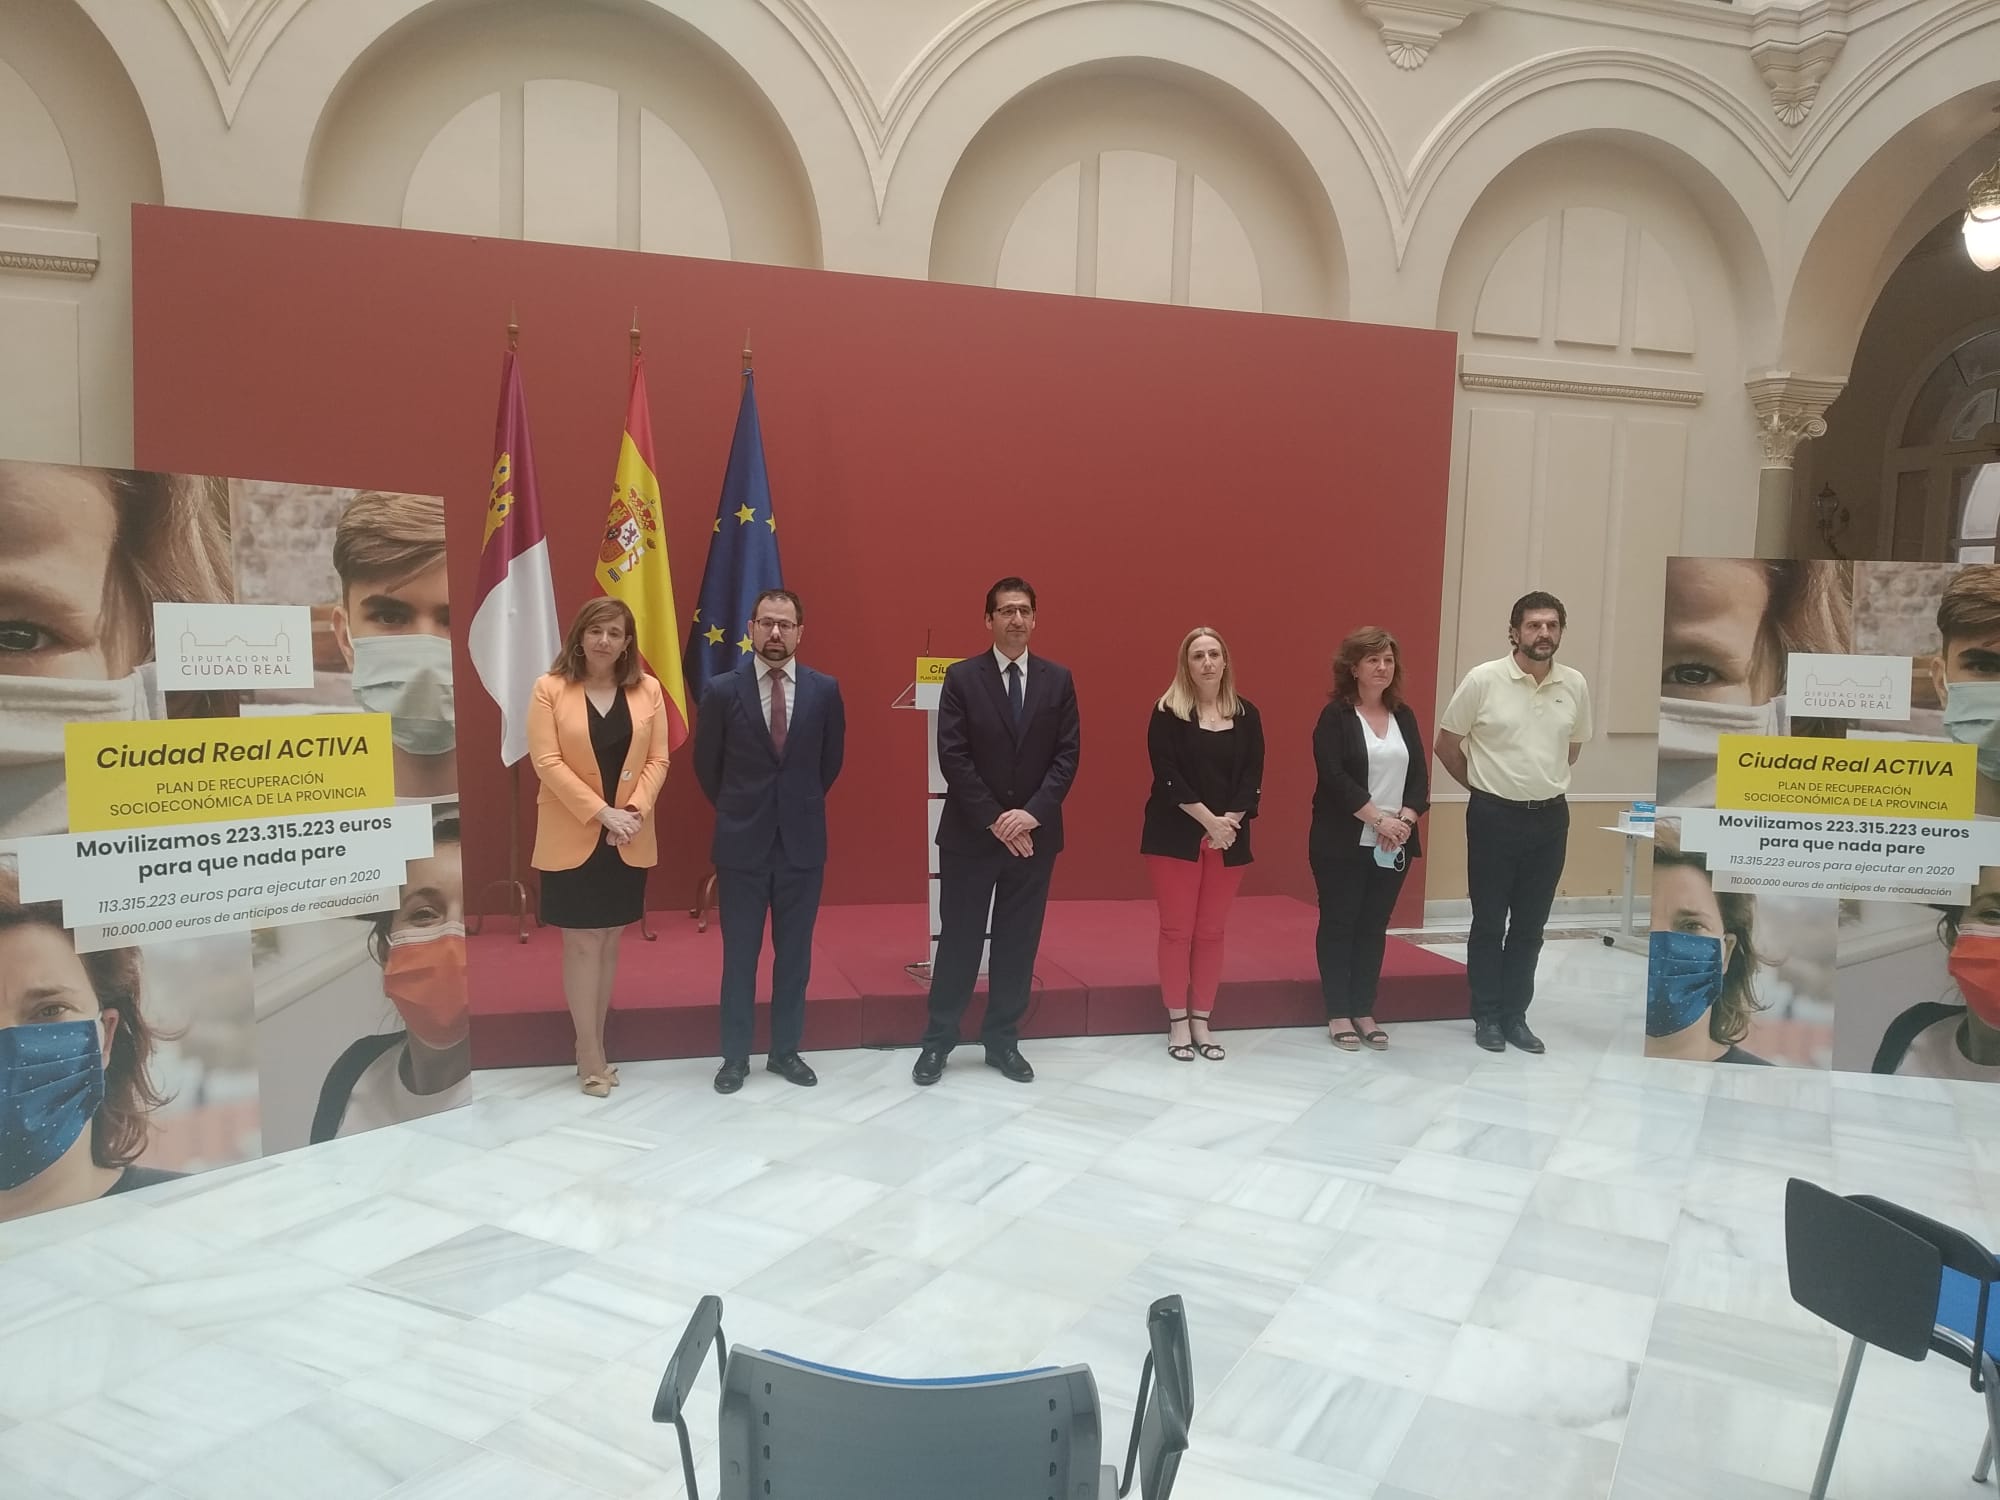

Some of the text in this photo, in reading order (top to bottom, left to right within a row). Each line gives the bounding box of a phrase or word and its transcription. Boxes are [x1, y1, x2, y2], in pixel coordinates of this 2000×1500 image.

[182, 664, 291, 675] CIUDAD REAL
[929, 664, 947, 674] Ciu
[1804, 698, 1892, 709] CIUDAD REAL
[96, 735, 369, 768] Ciudad Real ACTIVA
[1739, 752, 1953, 776] Ciudad Real ACTIVA
[156, 772, 324, 794] PLAN DE RECUPERACIÓN
[1778, 781, 1911, 795] PLAN DE RECUPERACIÓN
[110, 787, 366, 816] SOCIOECONÓMICA DE LA PROVINCIA
[1744, 792, 1947, 810] SOCIOECONÓMICA DE LA PROVINCIA
[76, 816, 392, 858] Movilizamos 223.315.223 euros
[1720, 815, 1969, 838] Movilizamos 223.315.223 euros
[1760, 837, 1925, 856] para que nada pare
[138, 844, 346, 882] para que nada pare
[1787, 860, 1820, 870] euros
[1823, 861, 1852, 873] para
[1855, 862, 1905, 875] ejecutar
[1908, 866, 1923, 874] en
[1927, 865, 1954, 876] 2020
[99, 868, 381, 913] 113.315.223 euros para ejecutar en 2020
[1812, 880, 1824, 889] de
[1827, 881, 1870, 893] anticipos
[1873, 883, 1885, 892] de
[1888, 884, 1952, 897] recaudación
[102, 893, 379, 937] 110.000.000 euros de anticipos de recaudación
